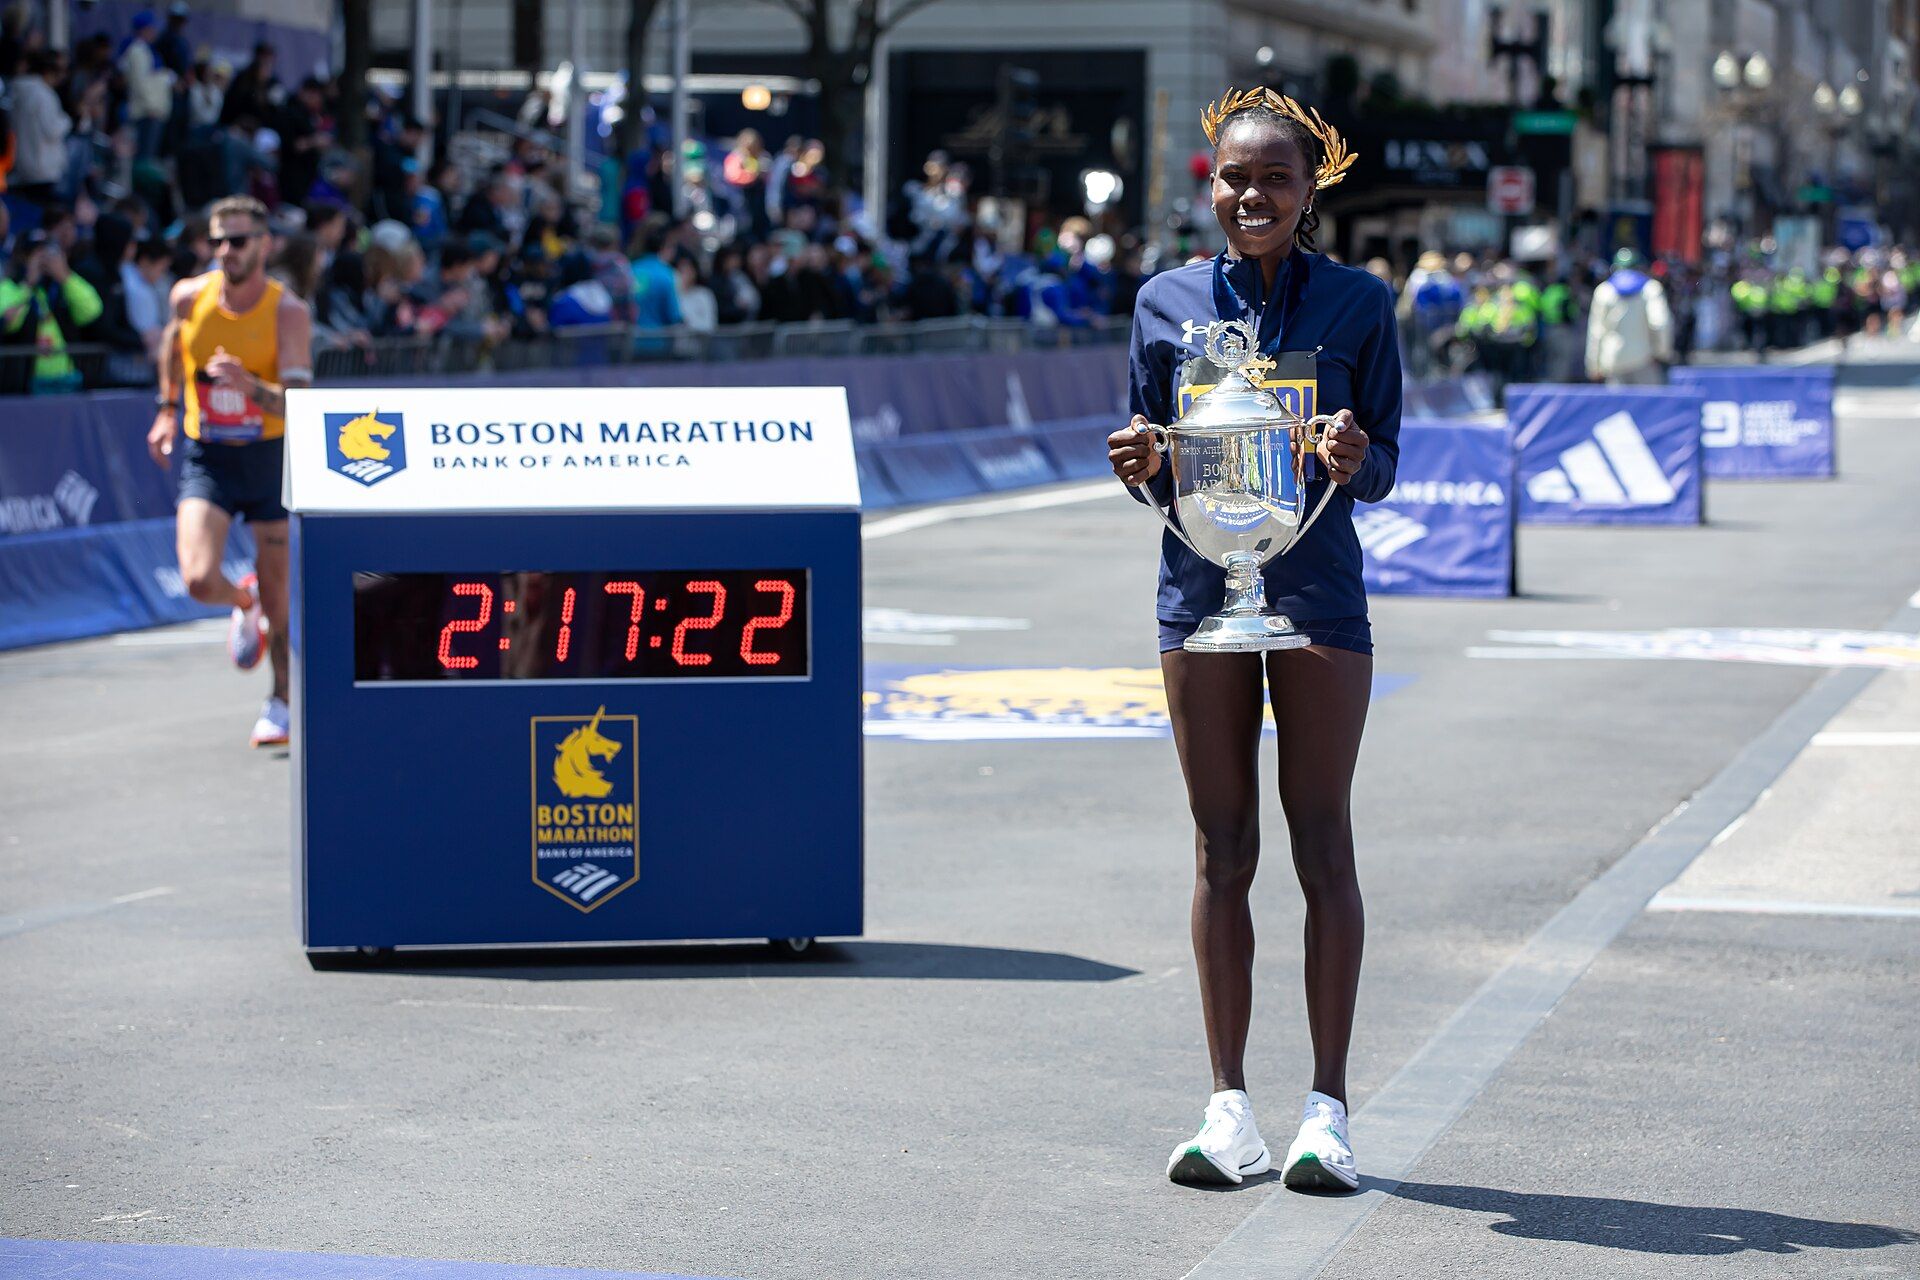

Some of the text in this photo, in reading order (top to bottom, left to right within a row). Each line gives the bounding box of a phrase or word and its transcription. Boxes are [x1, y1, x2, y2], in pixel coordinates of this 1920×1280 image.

[430, 420, 814, 444] BOSTON MARATHON
[433, 453, 691, 469] BANK OF AMERICA
[438, 580, 796, 668] 2:17:22
[538, 803, 634, 826] BOSTON
[538, 826, 634, 843] MARATHON
[538, 846, 634, 859] BANK OF AMERICA
